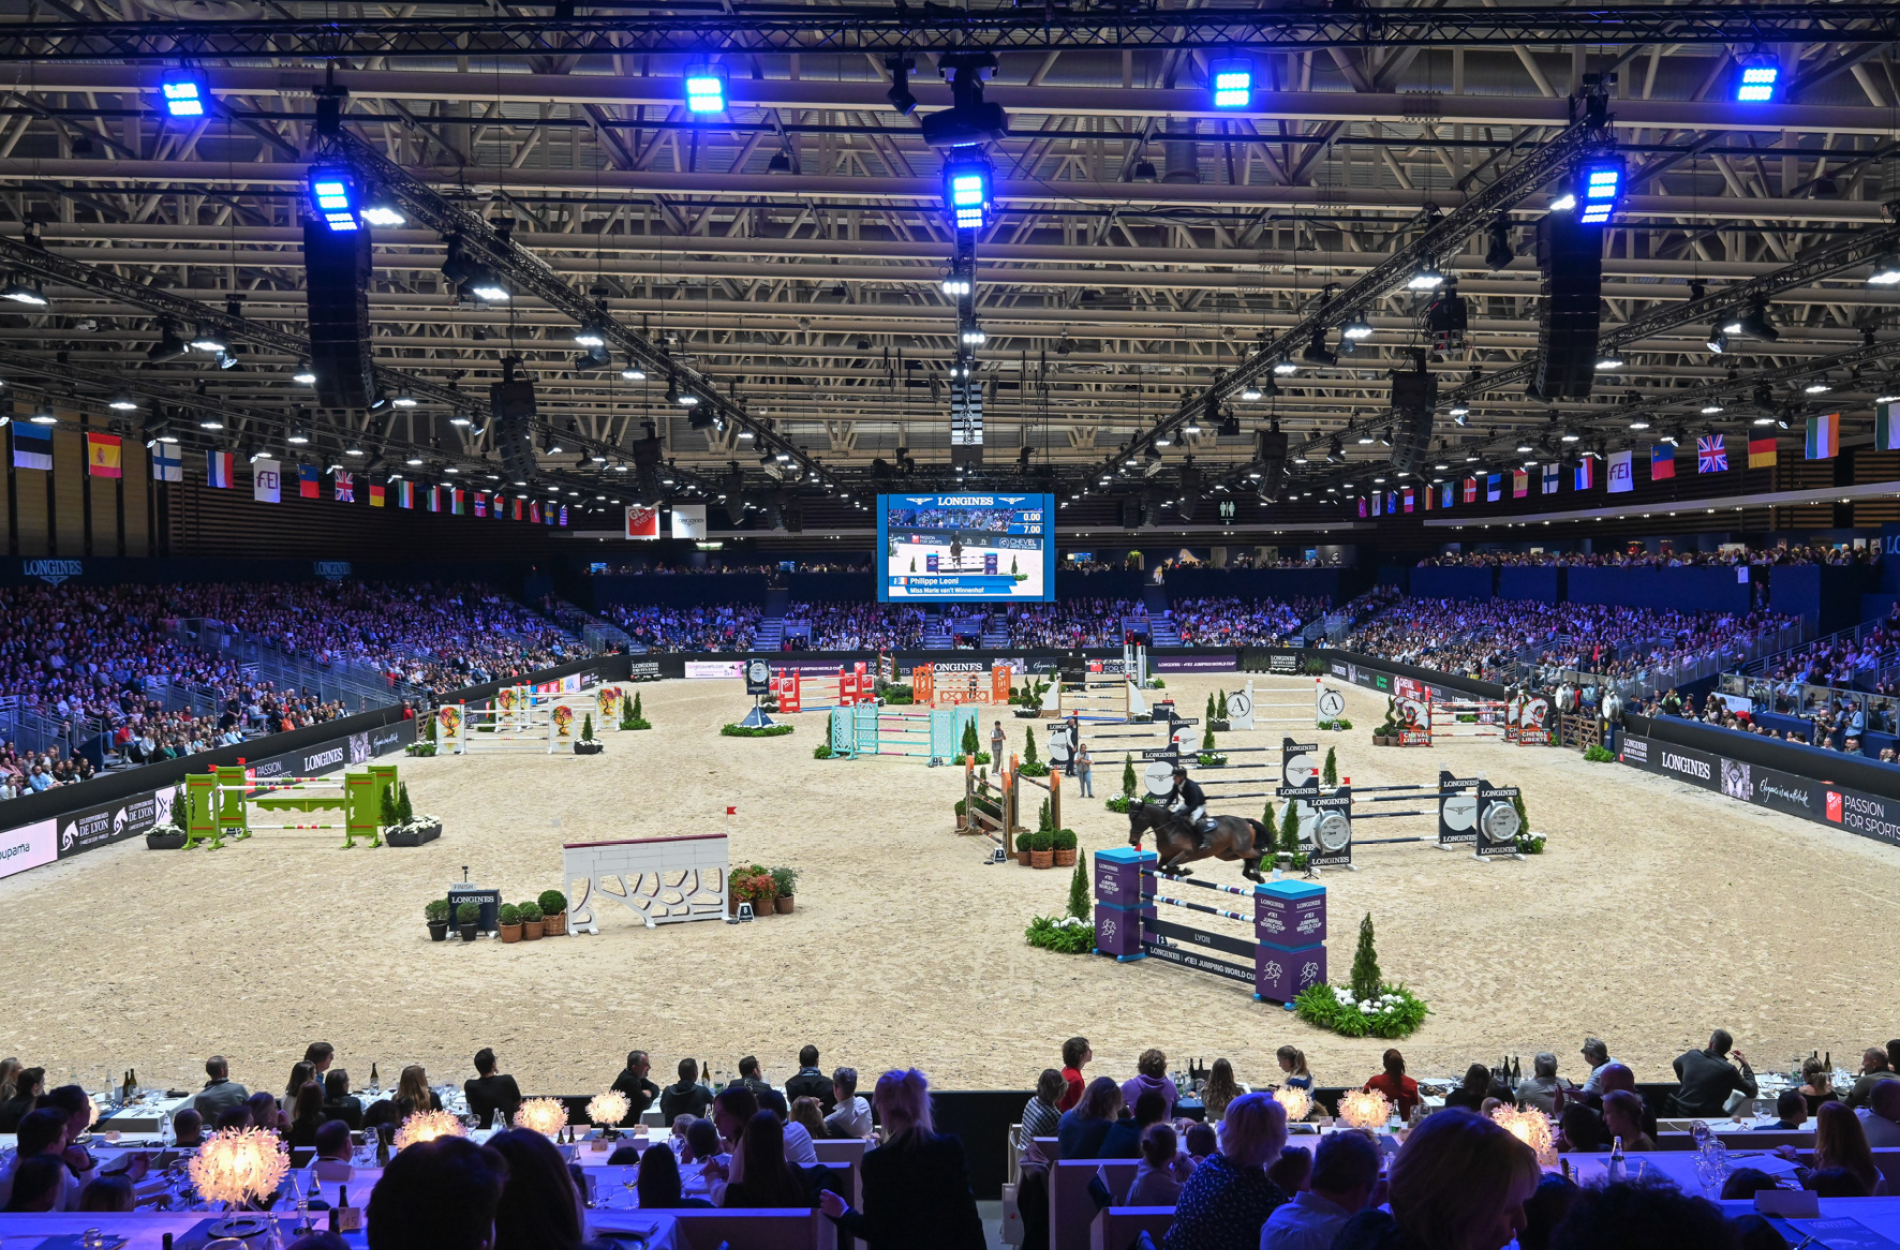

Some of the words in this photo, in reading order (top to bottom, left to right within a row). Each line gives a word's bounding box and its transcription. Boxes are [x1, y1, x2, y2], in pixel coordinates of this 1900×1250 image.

[937, 497, 994, 506] LONGINES
[1023, 513, 1041, 521] 0.00
[1023, 525, 1041, 534] 7.00
[23, 560, 83, 576] LONGINES
[910, 577, 938, 586] Philippe
[1286, 744, 1317, 752] LONGINES
[303, 747, 344, 772] LONGINES
[256, 761, 282, 777] PASSION
[1661, 751, 1711, 781] LONGINES
[1443, 780, 1479, 788] LONGINES
[1280, 788, 1318, 796] LONGINES
[1481, 789, 1518, 798] LONGINES
[1312, 798, 1350, 807] LONGINES
[1844, 795, 1885, 818] PASSION
[1844, 812, 1864, 831] FOR
[1865, 818, 1900, 841] SPORTS
[1443, 834, 1477, 843] LONGINES
[0, 843, 30, 860] upama
[1480, 846, 1517, 855] LONGINES
[1312, 857, 1350, 865] LONGINES
[451, 896, 495, 904] LONGINES
[1260, 898, 1285, 909] LONGINES
[1296, 899, 1321, 909] LONGINES
[743, 906, 748, 914] 8
[1263, 917, 1283, 926] JUMPING
[1299, 917, 1320, 926] JUMPING
[1194, 933, 1211, 944] LYON
[1149, 946, 1180, 961] LONGINES
[1198, 960, 1224, 972] JUMPING
[1224, 966, 1246, 978] WORLD
[1246, 971, 1256, 981] CU
[343, 1217, 358, 1228] 45
